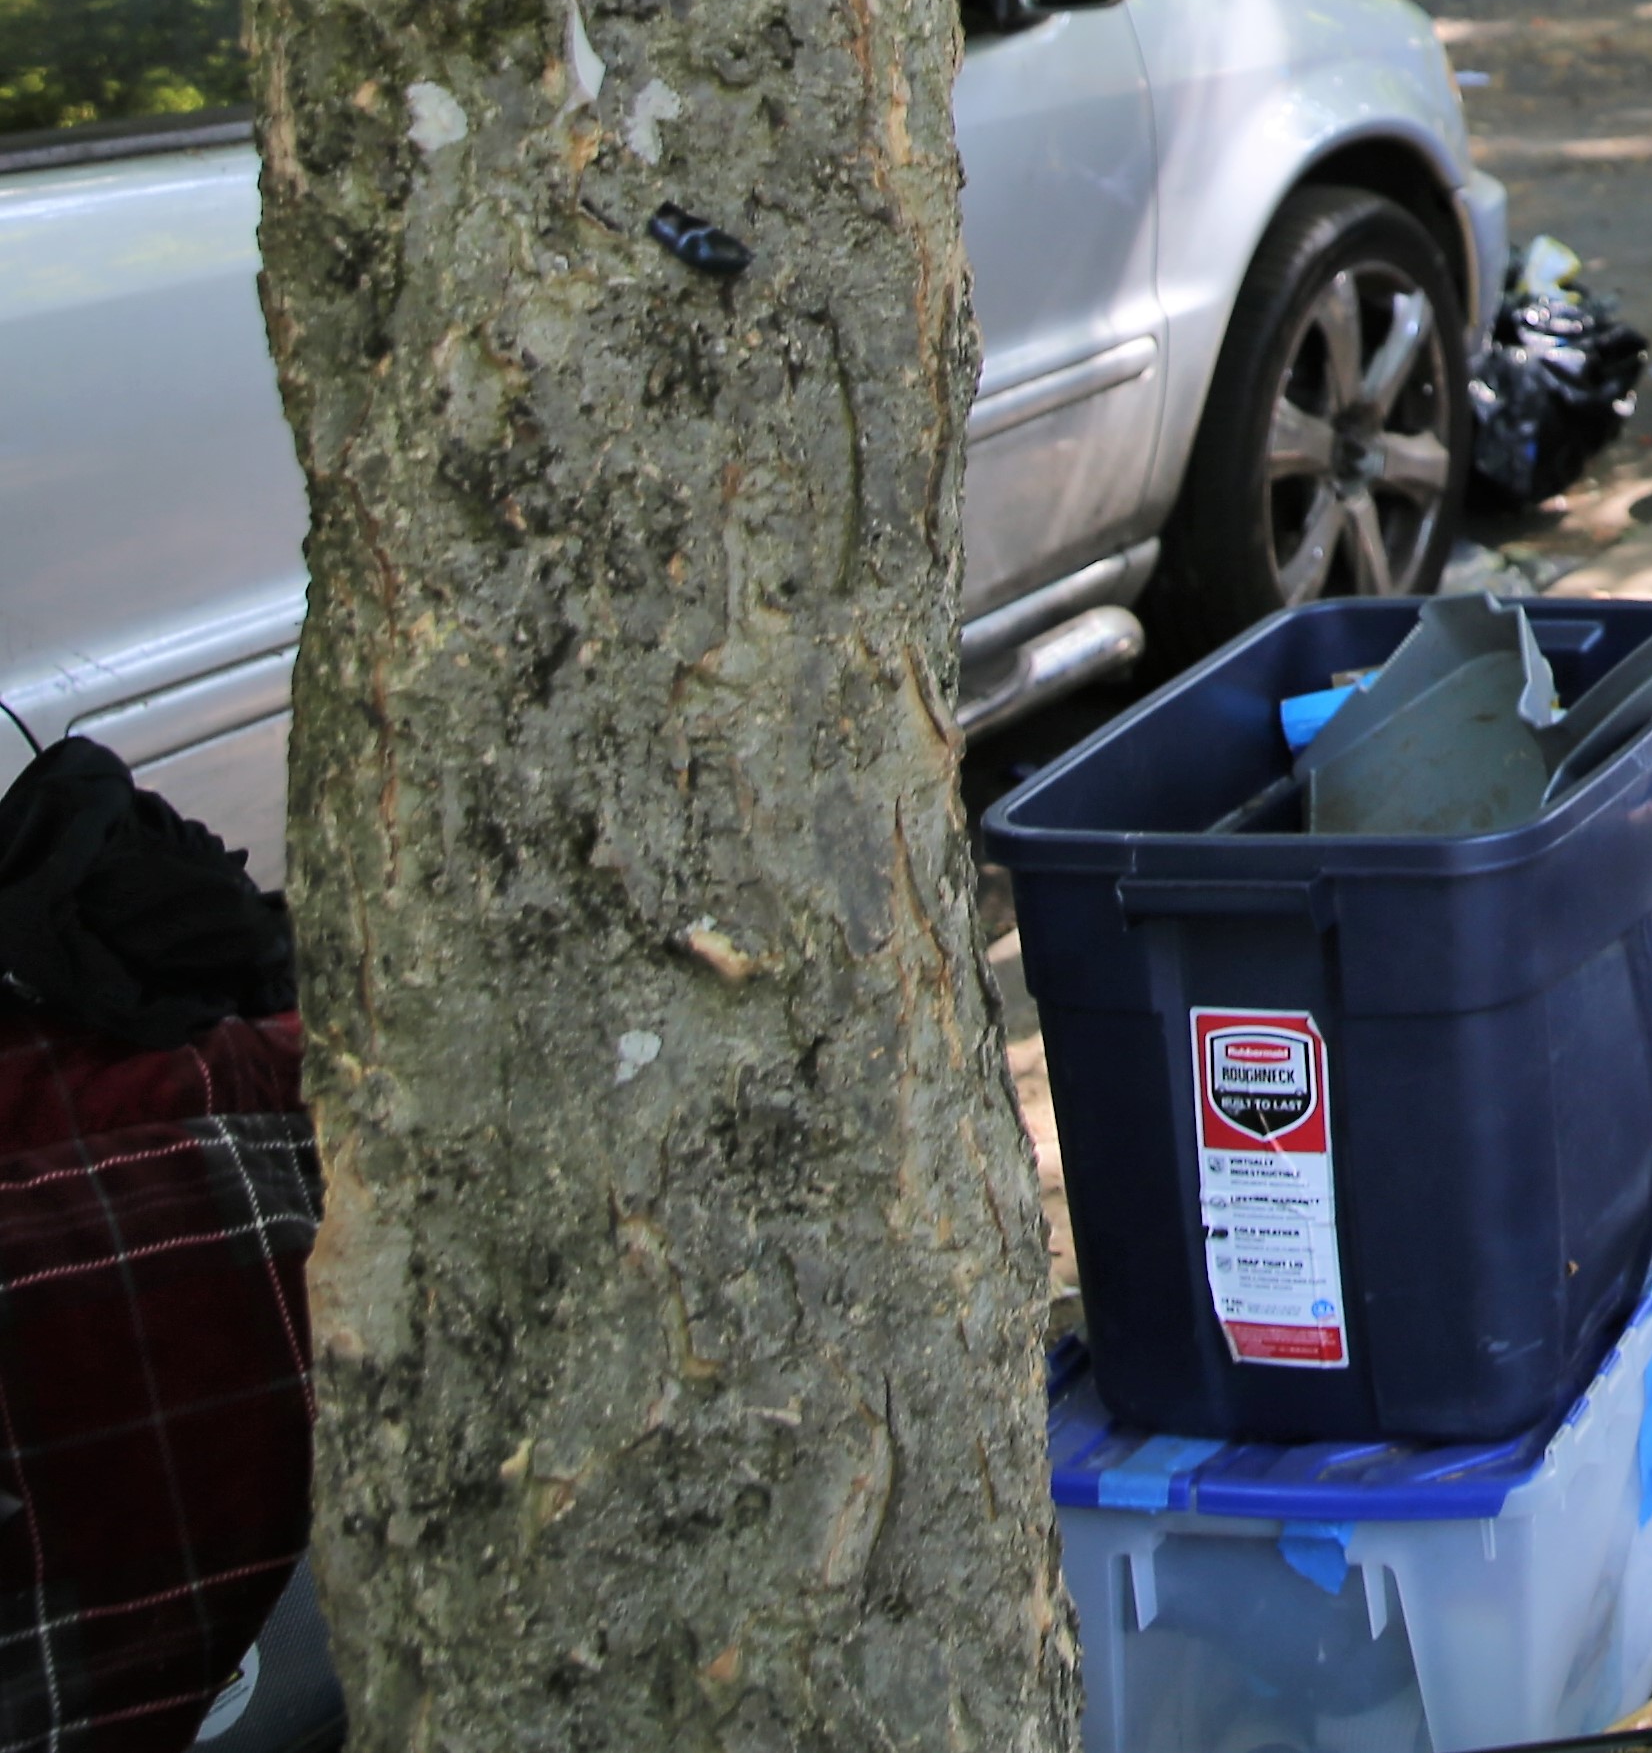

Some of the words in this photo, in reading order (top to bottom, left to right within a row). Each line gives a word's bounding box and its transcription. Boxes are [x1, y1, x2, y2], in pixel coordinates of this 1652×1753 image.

[1222, 1065, 1295, 1084] ROUGHNECK
[1221, 1095, 1251, 1110] BUILT
[1254, 1098, 1270, 1111] TO
[1273, 1099, 1302, 1112] LAST
